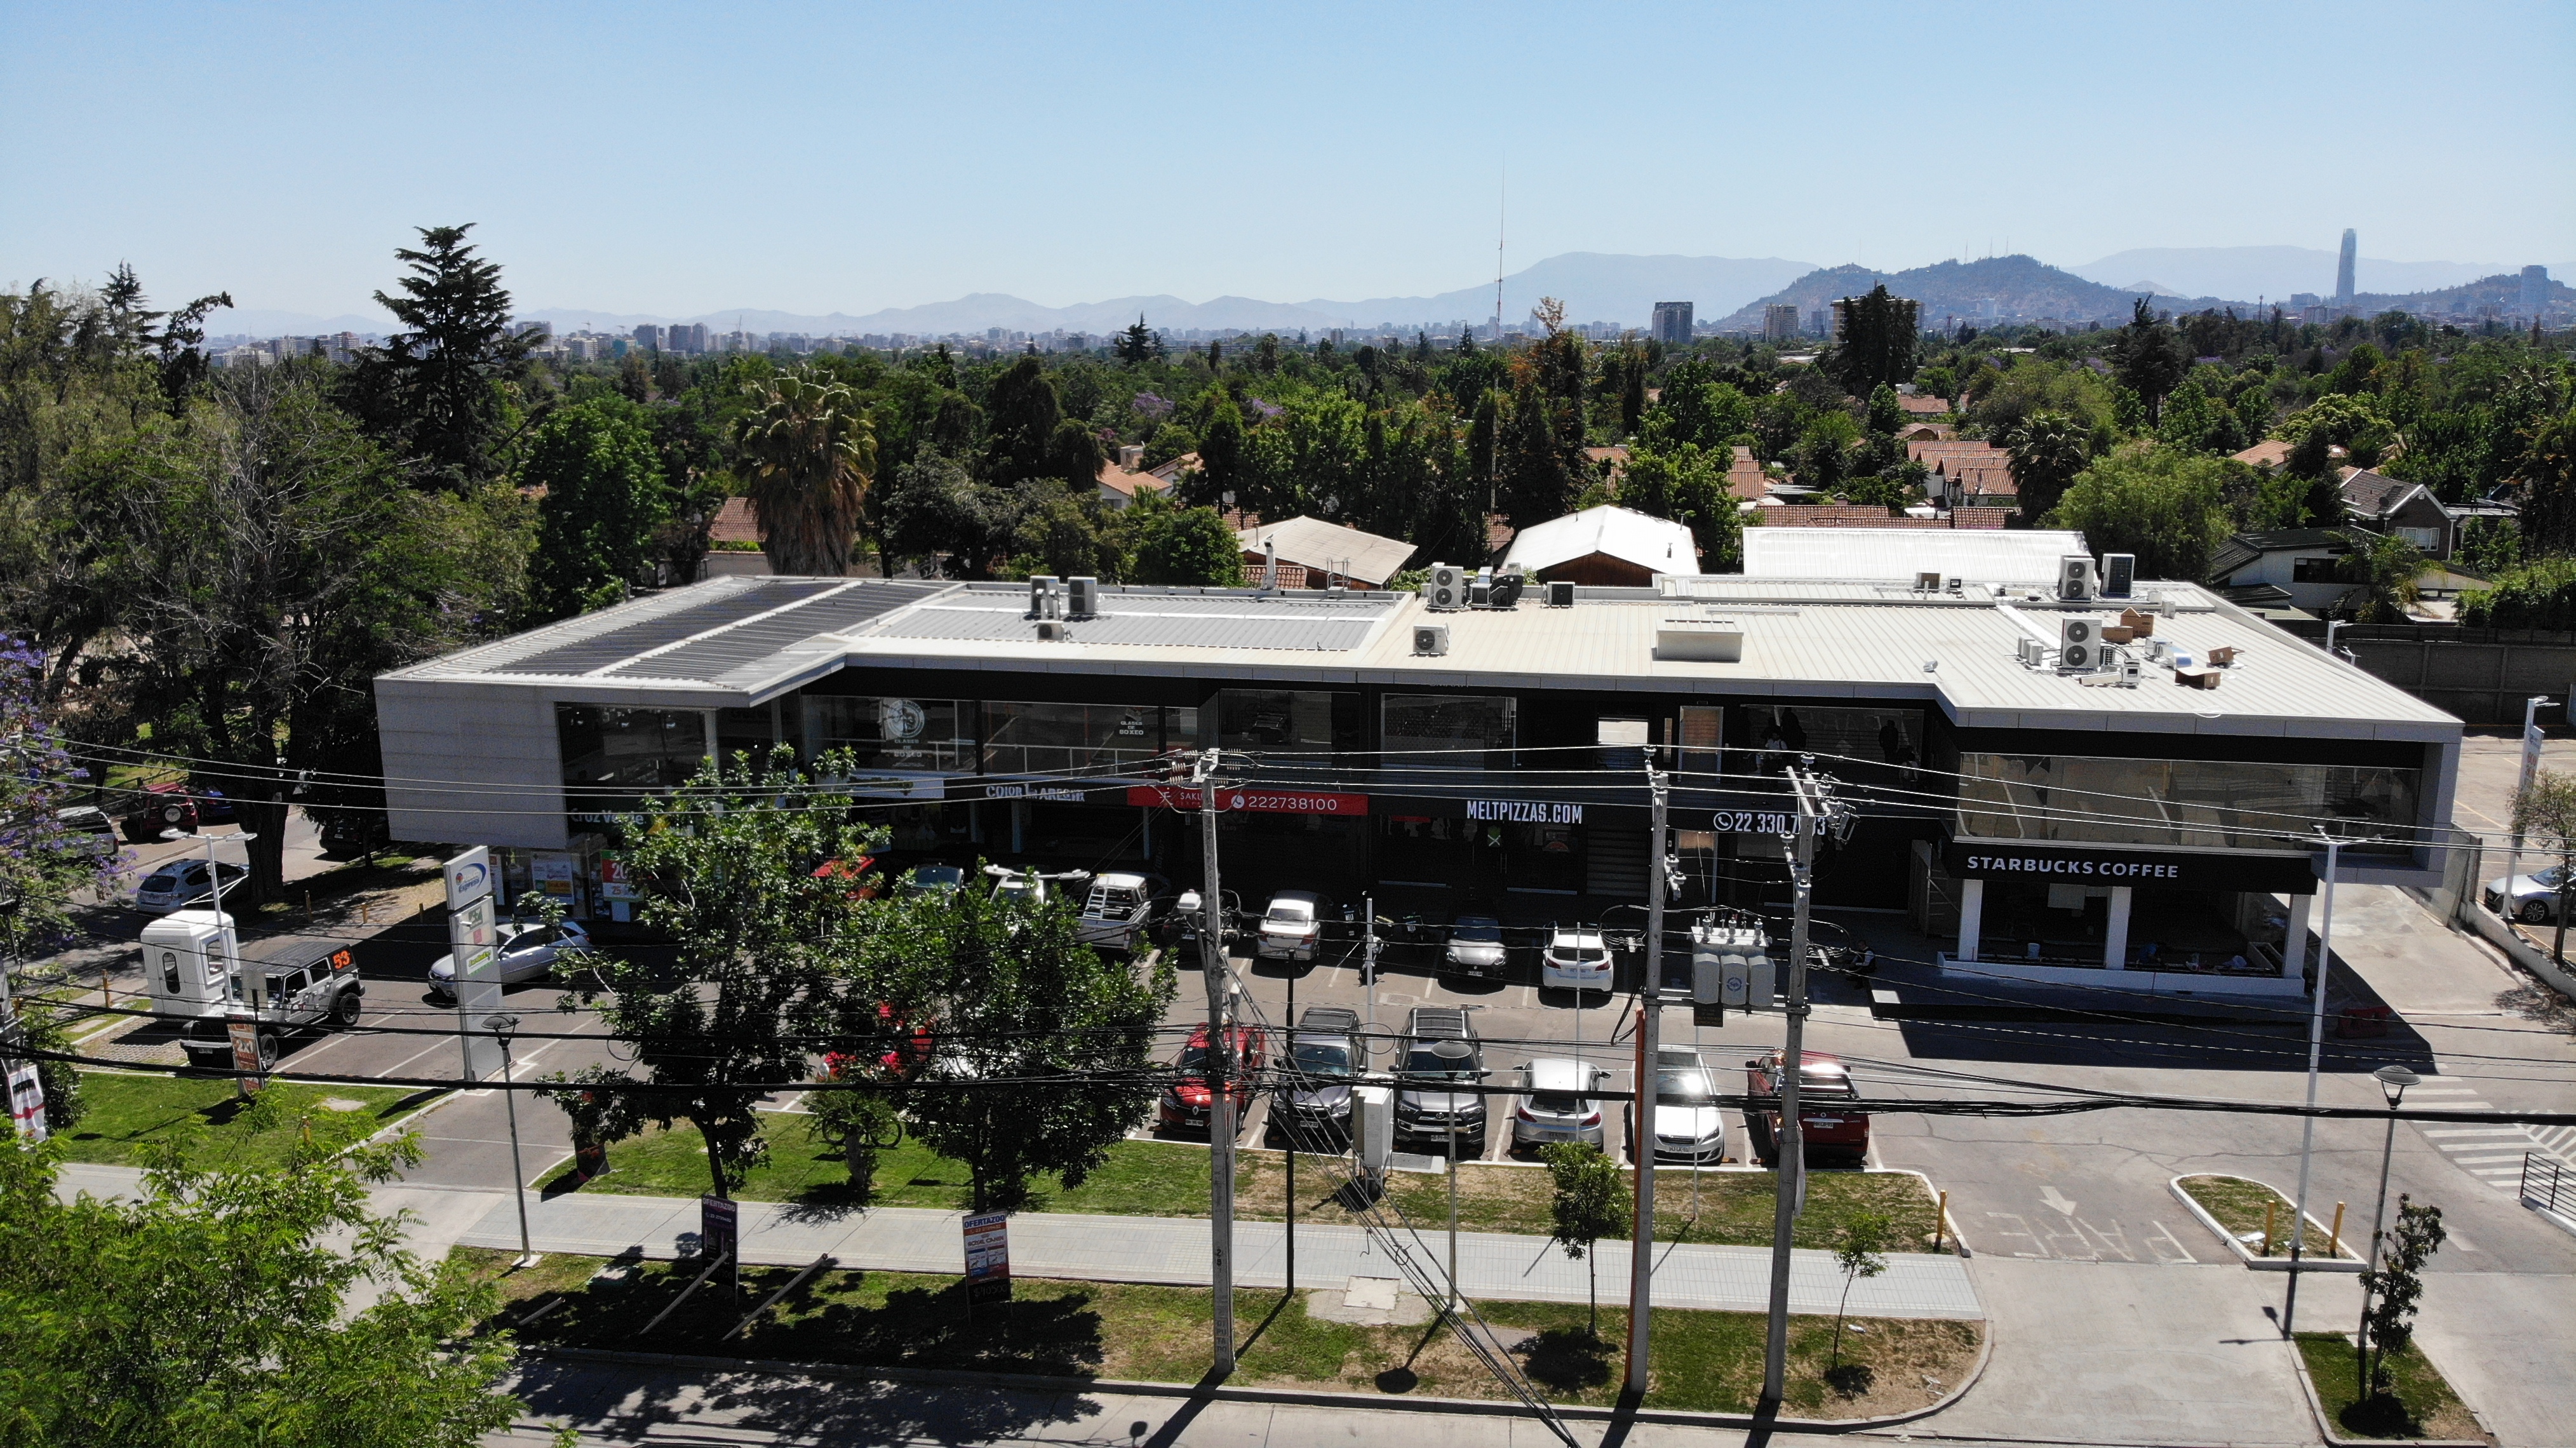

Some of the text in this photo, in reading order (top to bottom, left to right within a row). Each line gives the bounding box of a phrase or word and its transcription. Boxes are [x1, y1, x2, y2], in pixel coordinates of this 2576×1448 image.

[1248, 796, 1337, 810] 222738100
[1467, 800, 1582, 824] MELTPIZZAS.COM
[1735, 812, 1826, 836] 22 330 73
[1968, 856, 2178, 878] STARBUCKS COFFEE
[964, 1214, 1005, 1228] OFERTAZOO
